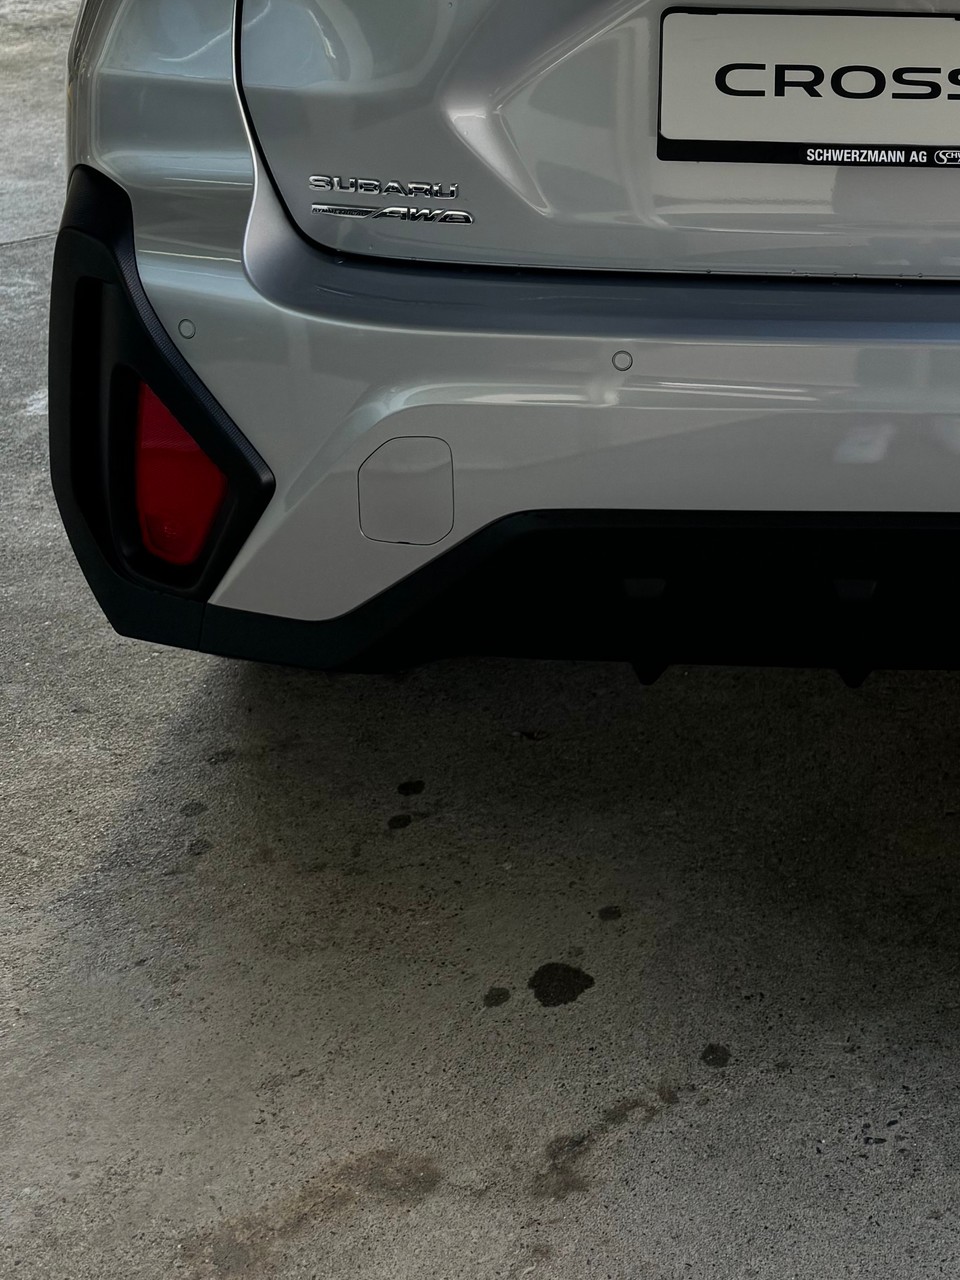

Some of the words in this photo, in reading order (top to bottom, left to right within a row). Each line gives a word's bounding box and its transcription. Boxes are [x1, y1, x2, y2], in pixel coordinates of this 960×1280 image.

[806, 148, 905, 164] SCHWERZMANN
[909, 150, 928, 164] AG
[308, 174, 459, 200] SUBARU
[372, 206, 475, 226] AWD
